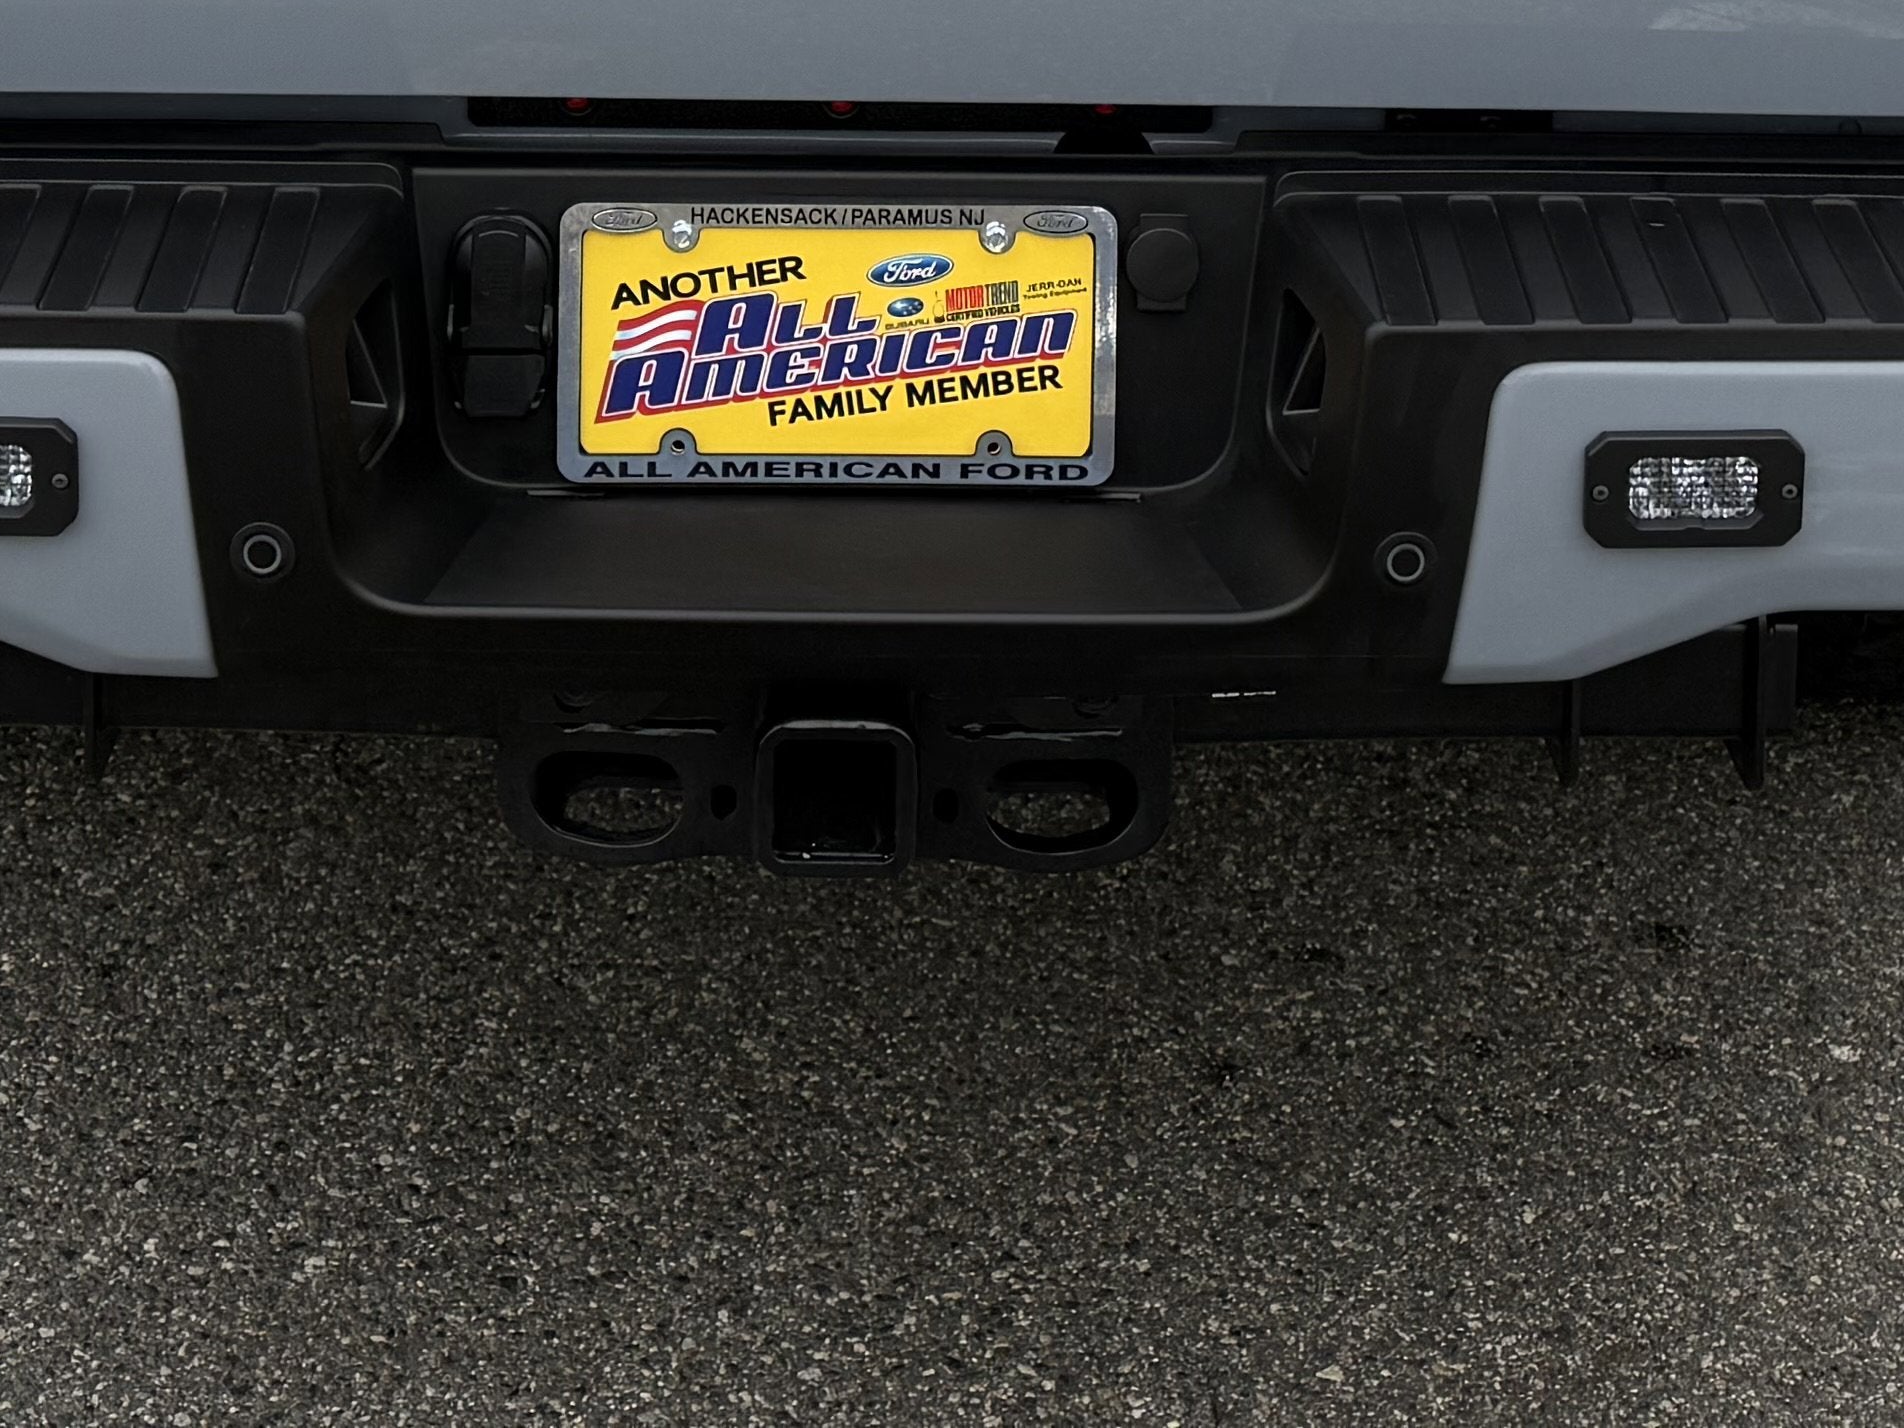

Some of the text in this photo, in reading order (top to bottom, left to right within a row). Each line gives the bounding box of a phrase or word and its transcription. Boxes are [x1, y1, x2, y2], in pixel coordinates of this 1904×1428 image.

[958, 208, 985, 226] NJ
[610, 256, 807, 310] ANOTHER
[883, 258, 937, 283] Ford
[945, 279, 1019, 313] MOTOR TREND
[768, 364, 1063, 427] FAMILY MEMBER
[583, 460, 1090, 482] ALL AMERICAN FORD
